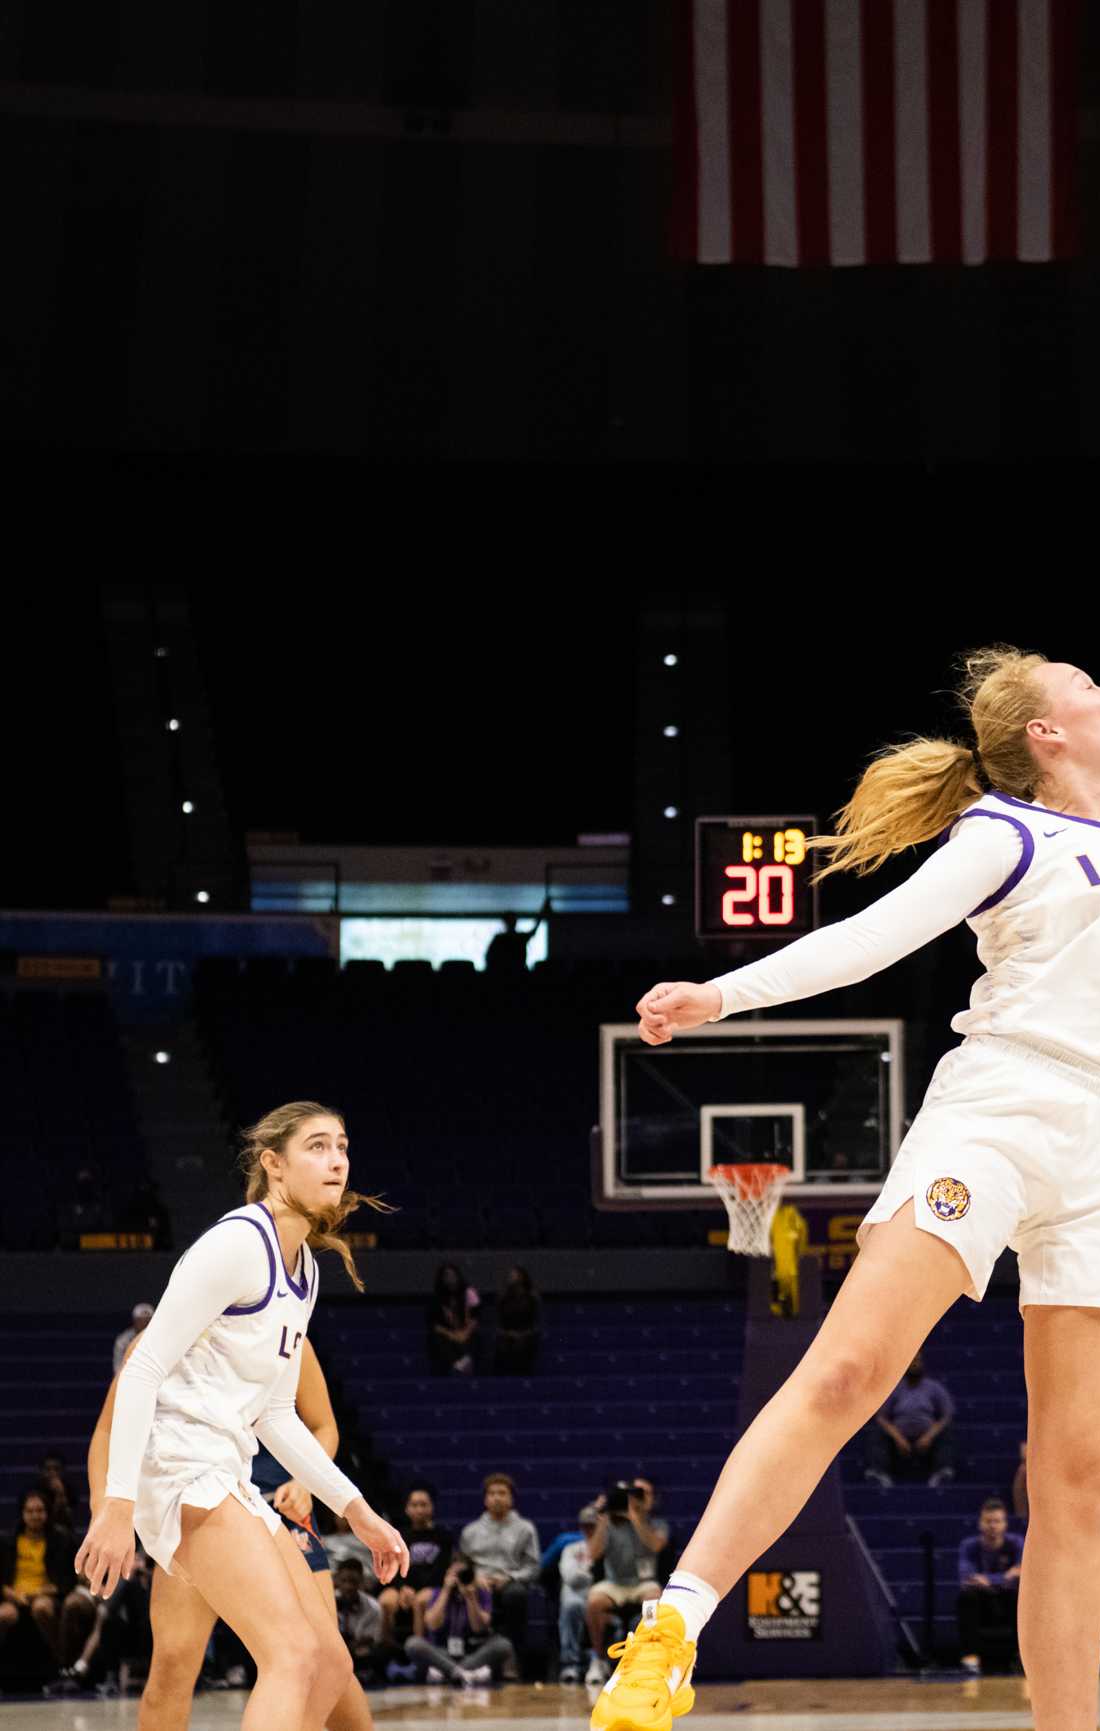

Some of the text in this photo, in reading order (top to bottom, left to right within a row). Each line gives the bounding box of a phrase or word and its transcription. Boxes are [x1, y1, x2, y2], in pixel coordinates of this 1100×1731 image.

[742, 828, 806, 865] 1:13
[722, 864, 794, 926] 20
[747, 1571, 821, 1616] H&E
